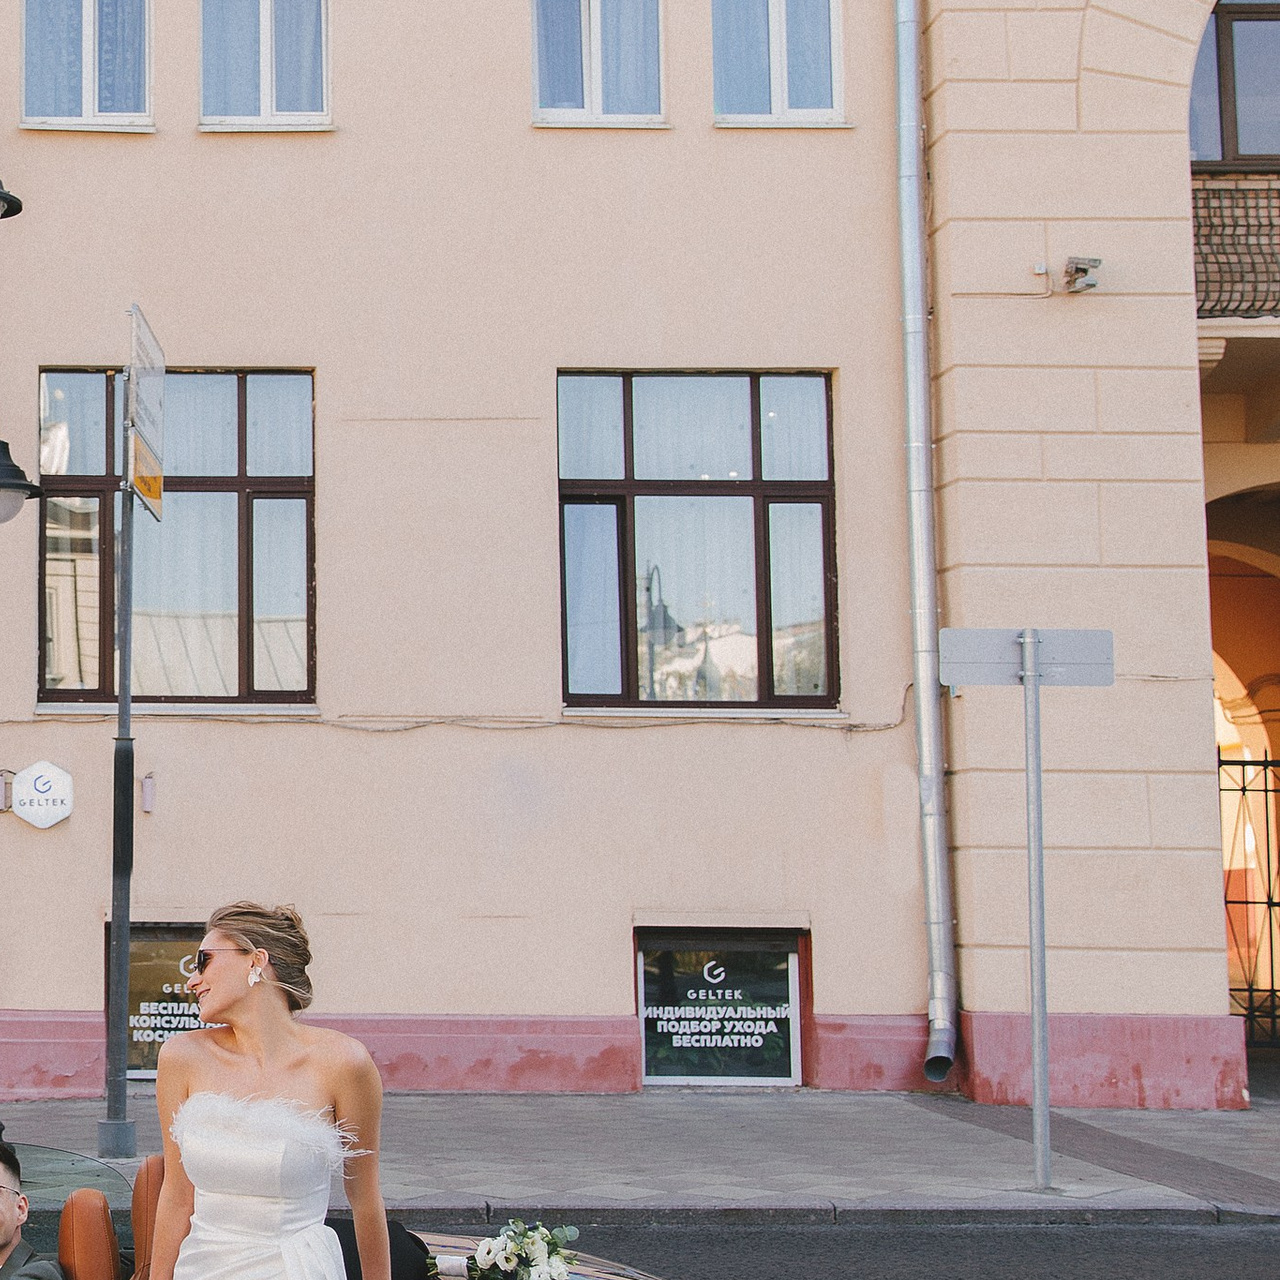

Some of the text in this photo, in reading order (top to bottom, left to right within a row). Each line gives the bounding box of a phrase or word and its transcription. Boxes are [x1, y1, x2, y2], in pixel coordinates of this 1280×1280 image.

[19, 798, 66, 807] GELTEK
[162, 983, 197, 994] GEL
[687, 989, 743, 1000] GELTEK
[140, 1002, 200, 1015] БЕСПЛА
[643, 1004, 790, 1019] ИНДИВИДУАЛЬНЫЙ
[657, 1021, 778, 1034] ПОДБОР УХОДА
[672, 1035, 764, 1047] БЕСПЛАТНО
